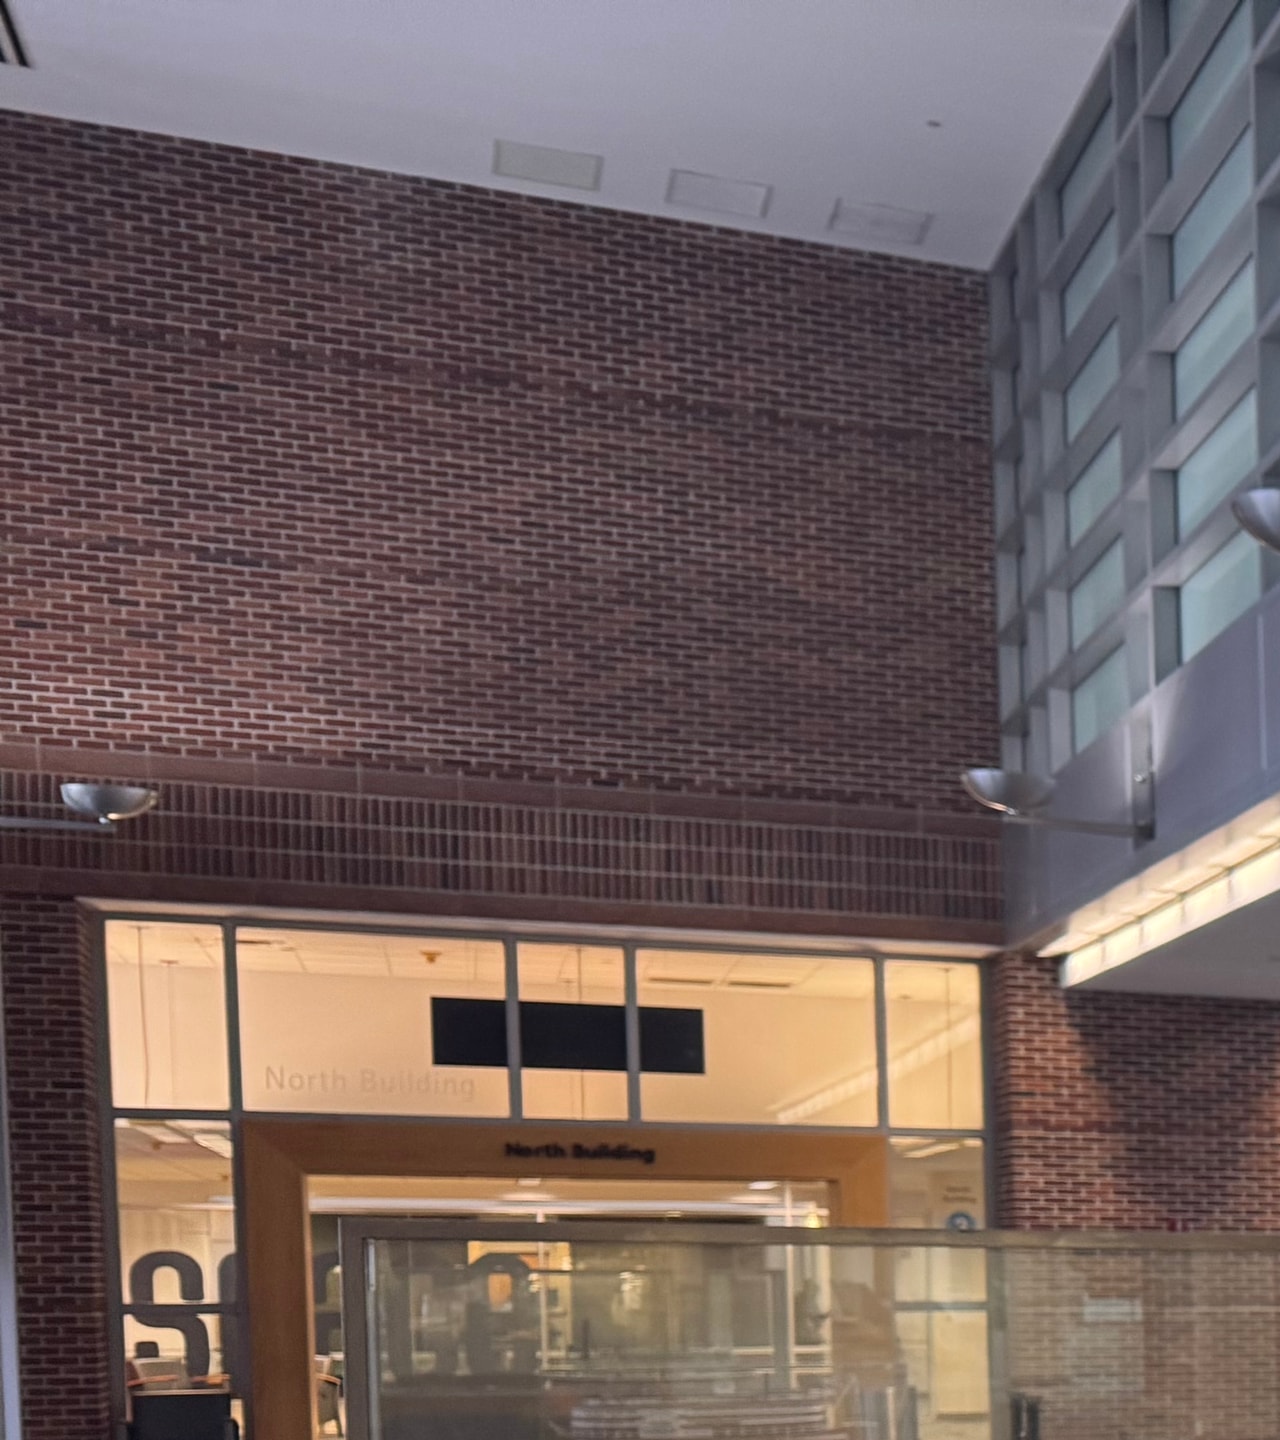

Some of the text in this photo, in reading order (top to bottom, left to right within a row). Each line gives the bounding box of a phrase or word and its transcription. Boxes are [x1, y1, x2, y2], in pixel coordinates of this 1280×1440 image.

[265, 1065, 476, 1102] North Building
[504, 1141, 656, 1165] North Building
